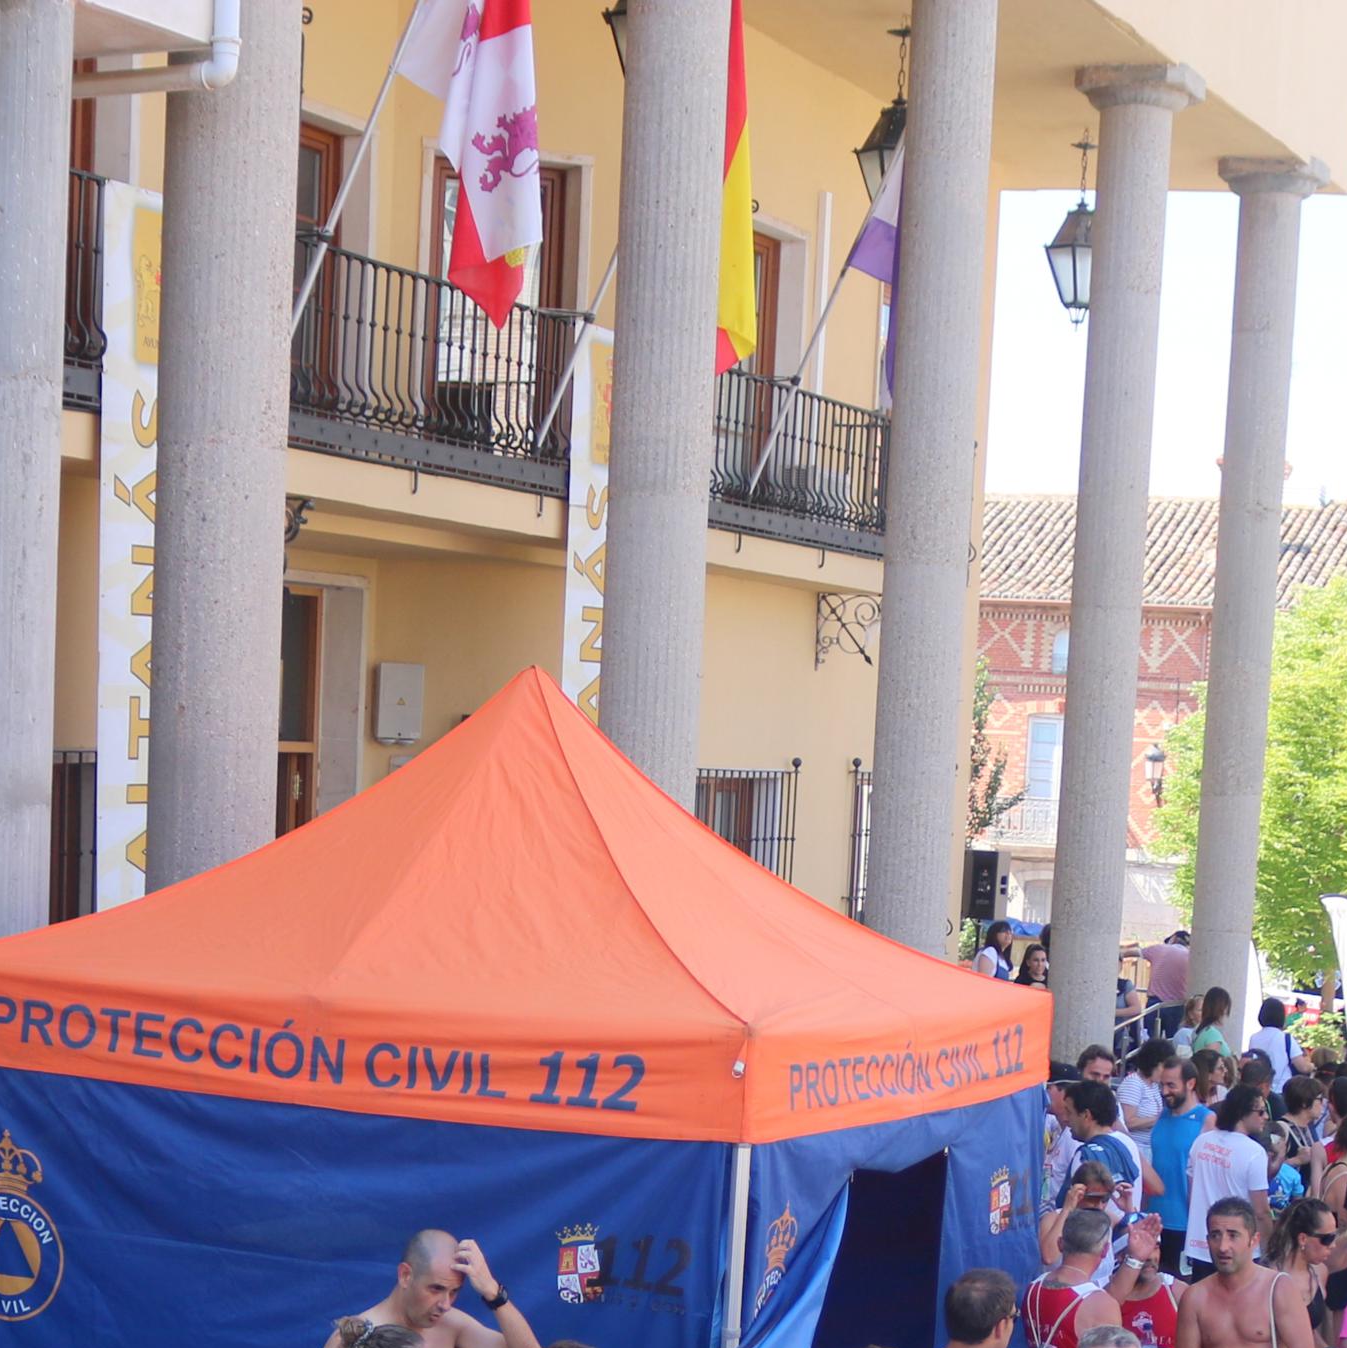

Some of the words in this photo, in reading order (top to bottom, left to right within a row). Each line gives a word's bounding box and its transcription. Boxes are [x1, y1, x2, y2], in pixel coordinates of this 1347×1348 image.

[365, 1042, 507, 1099] CIVIL
[529, 1050, 647, 1112] 112
[788, 1039, 935, 1111] PROTECCIÓN
[936, 1043, 990, 1088] CIVIL
[992, 1023, 1023, 1078] 112
[586, 1233, 693, 1297] 112
